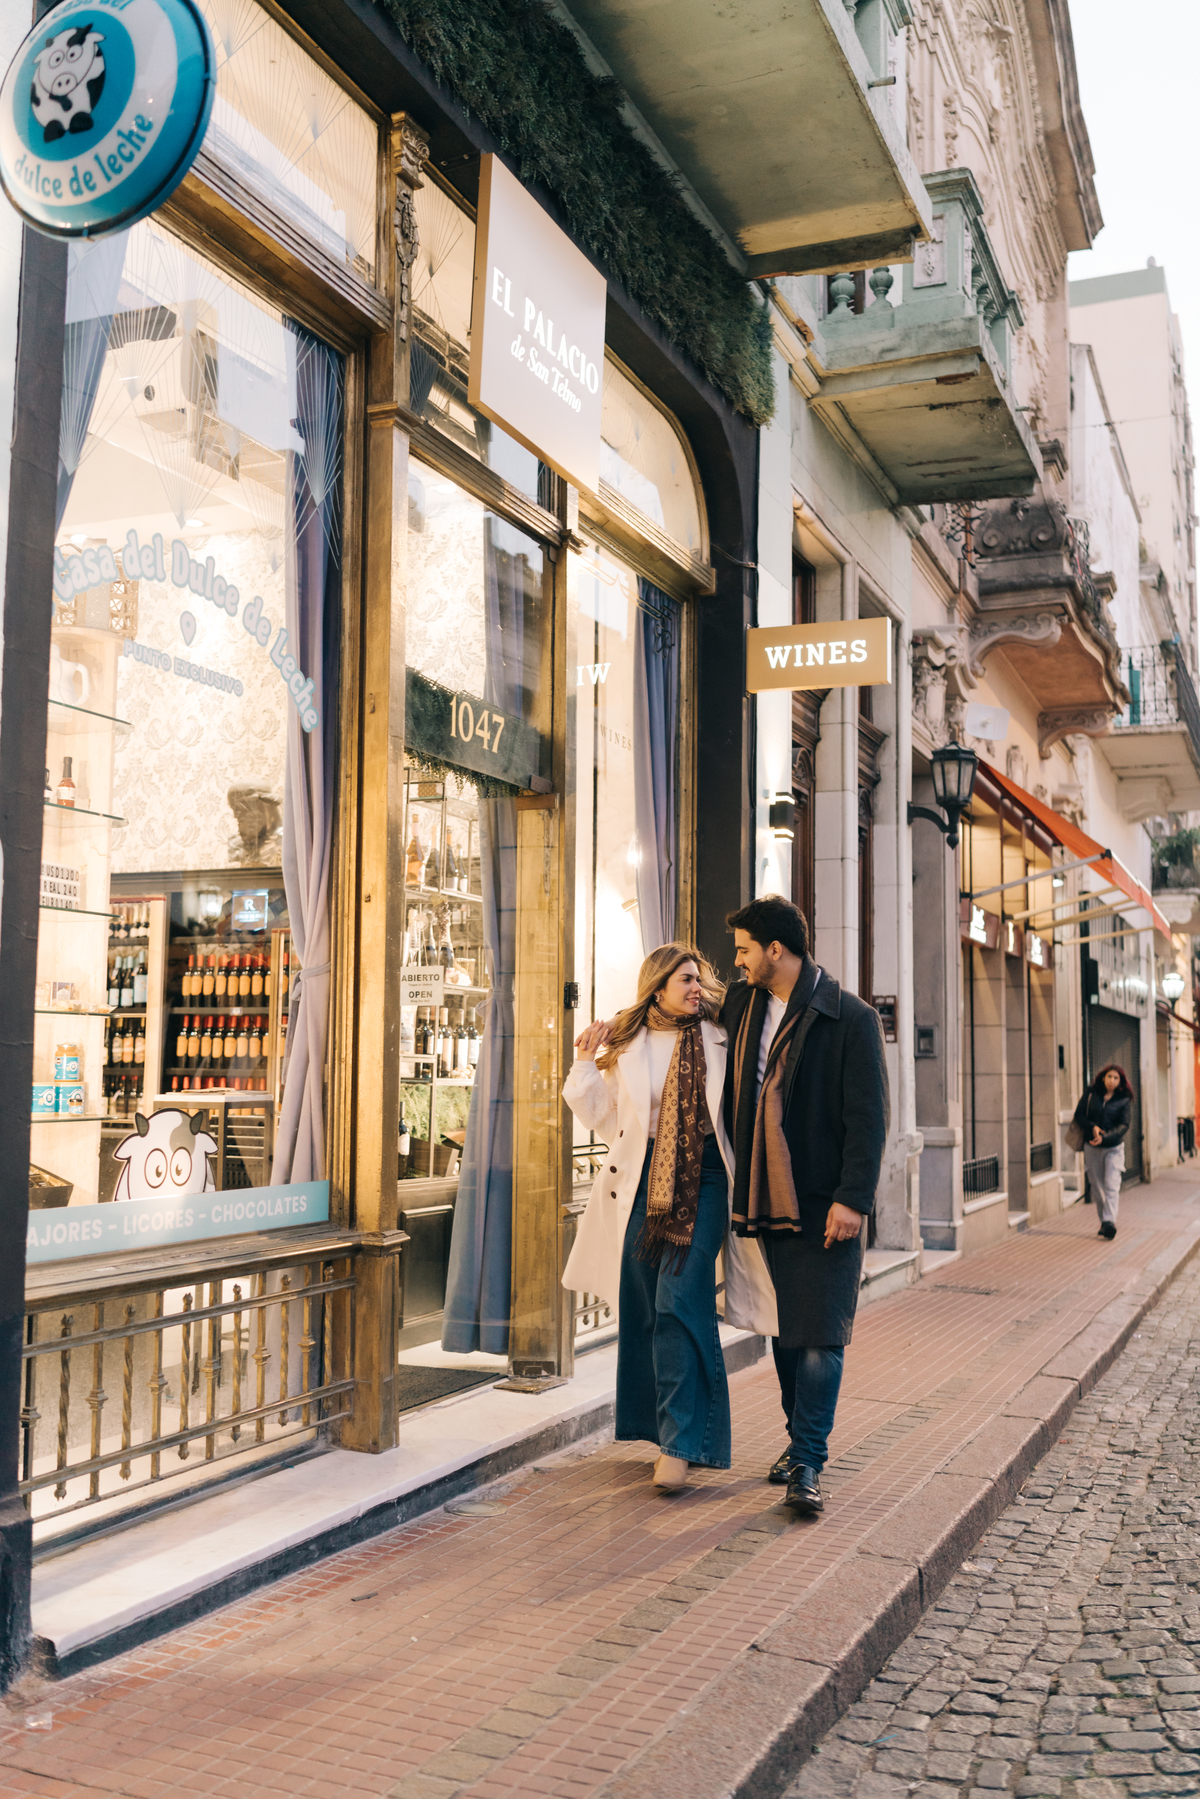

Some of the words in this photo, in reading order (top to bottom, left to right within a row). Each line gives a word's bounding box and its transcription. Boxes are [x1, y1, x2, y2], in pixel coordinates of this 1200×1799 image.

[14, 154, 63, 199] dulce
[69, 164, 97, 197] de
[94, 114, 154, 183] leche
[491, 266, 515, 318] EL
[523, 296, 599, 394] PALACIO
[510, 334, 526, 362] de
[526, 346, 550, 385] San
[551, 366, 582, 413] Telmo
[53, 545, 119, 602] Casa
[121, 528, 166, 583] del
[171, 538, 240, 617] Dulce
[242, 595, 272, 647] de
[269, 627, 319, 733] Leche
[764, 639, 868, 669] WINES
[123, 638, 172, 672] PUNTO
[173, 656, 244, 697] EXCLUSIVO
[449, 695, 505, 753] 1047
[600, 724, 632, 751] WINES
[401, 973, 440, 982] ABIERTO
[408, 990, 433, 999] OPEN
[26, 1219, 103, 1248] AJORES
[122, 1208, 194, 1236] LICORES
[211, 1195, 308, 1224] CHOCOLATES
